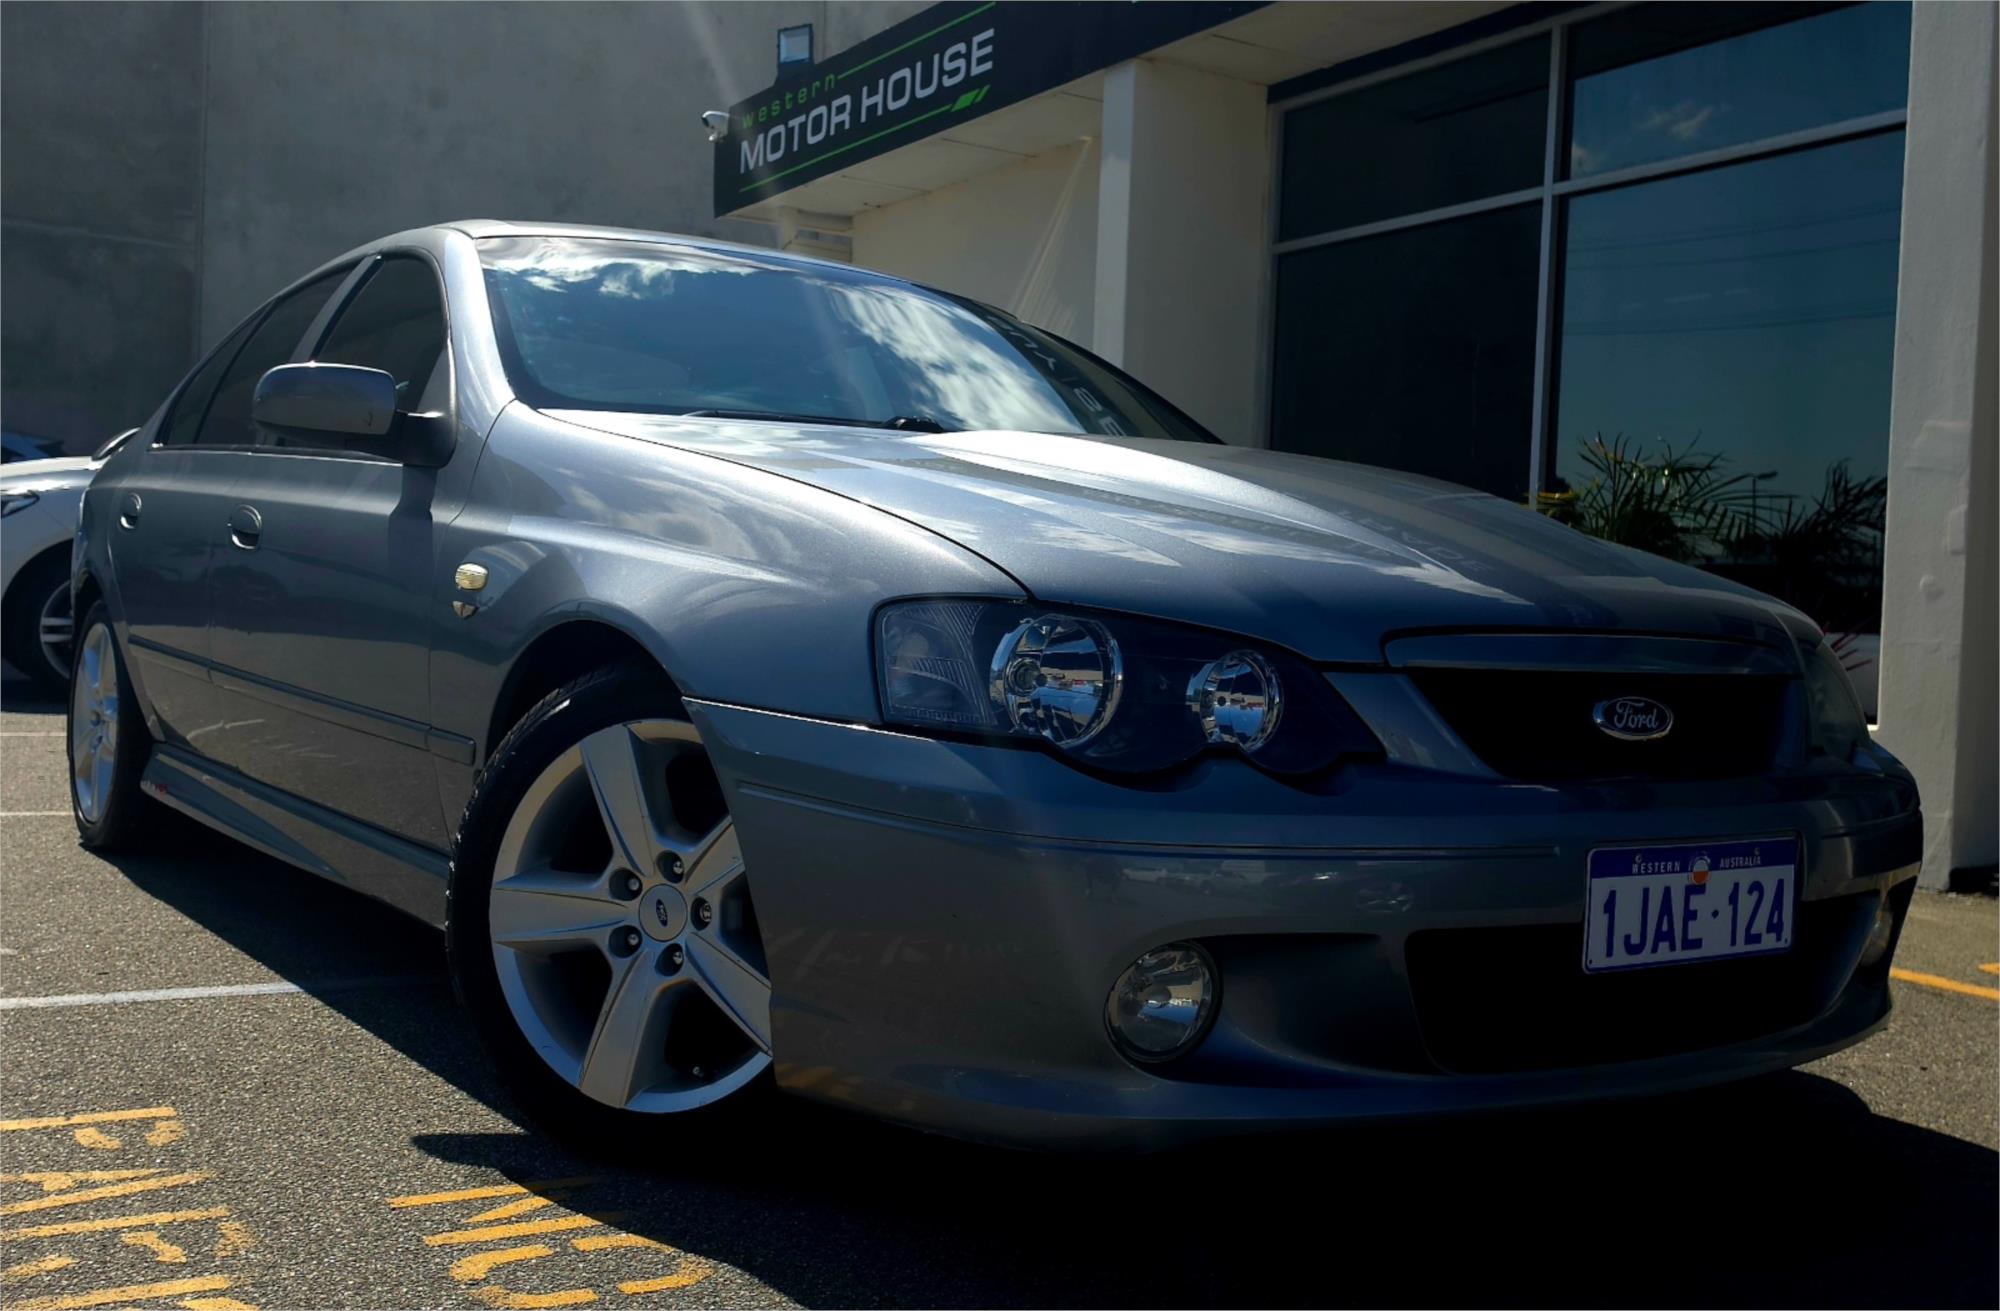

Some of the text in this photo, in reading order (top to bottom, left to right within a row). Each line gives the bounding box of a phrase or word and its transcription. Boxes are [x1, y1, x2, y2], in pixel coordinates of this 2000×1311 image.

[740, 28, 995, 174] MOTOR HOUSE
[741, 74, 836, 128] western
[1614, 700, 1659, 729] Ford
[1632, 855, 1762, 875] WESTERN AUSTRALIA
